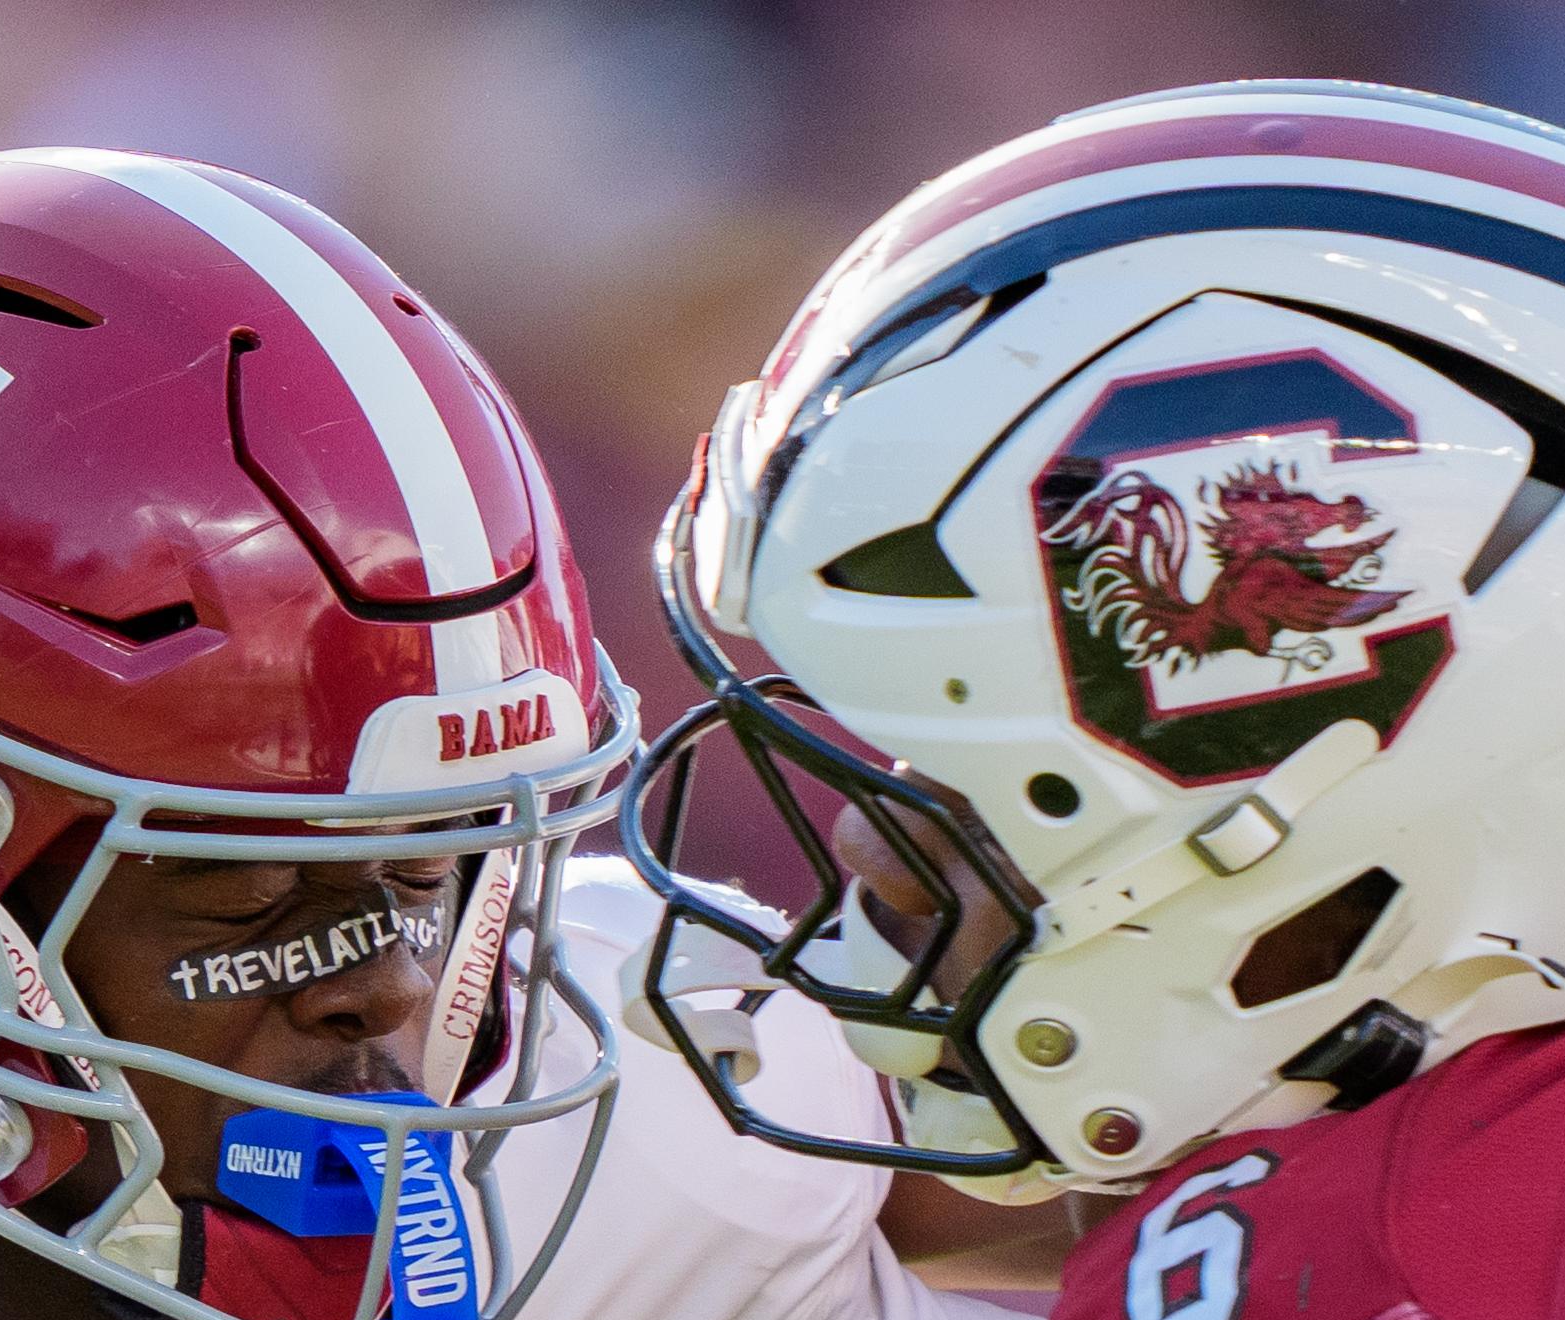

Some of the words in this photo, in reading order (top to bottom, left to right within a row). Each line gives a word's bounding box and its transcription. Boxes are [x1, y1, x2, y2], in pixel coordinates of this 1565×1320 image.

[437, 693, 556, 762] BAMA
[442, 872, 512, 1041] CRIMSON
[226, 1143, 303, 1180] NXTRND
[358, 1137, 469, 1309] NXTRND
